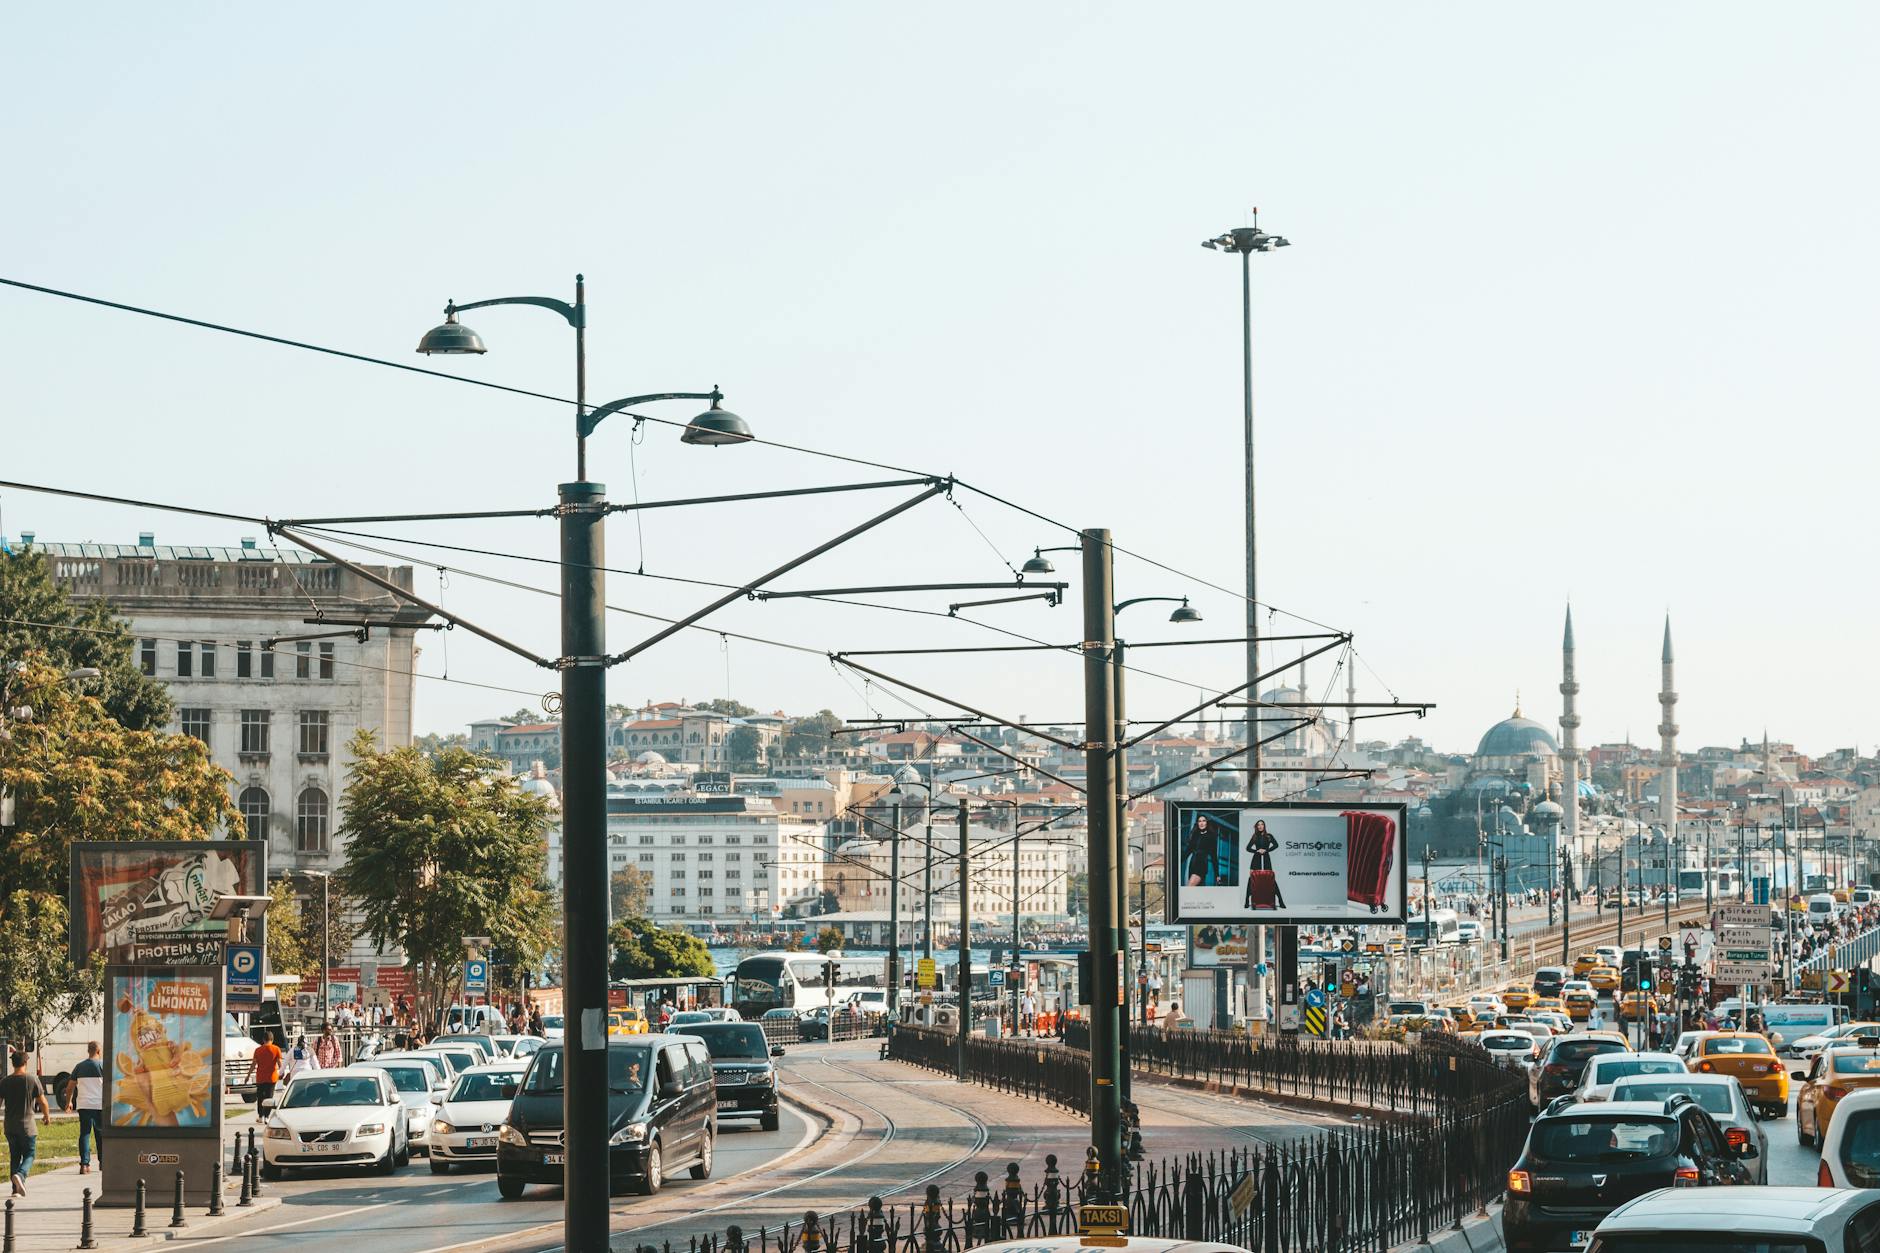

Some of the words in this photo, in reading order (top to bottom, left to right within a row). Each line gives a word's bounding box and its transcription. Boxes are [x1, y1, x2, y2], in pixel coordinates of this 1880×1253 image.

[1285, 841, 1343, 850] Samsonite
[161, 985, 179, 996] YENİ
[180, 986, 202, 997] NESİL
[151, 993, 208, 1010] LİMONATA
[1083, 1210, 1120, 1223] TAKSİ
[1577, 1231, 1589, 1242] 34
